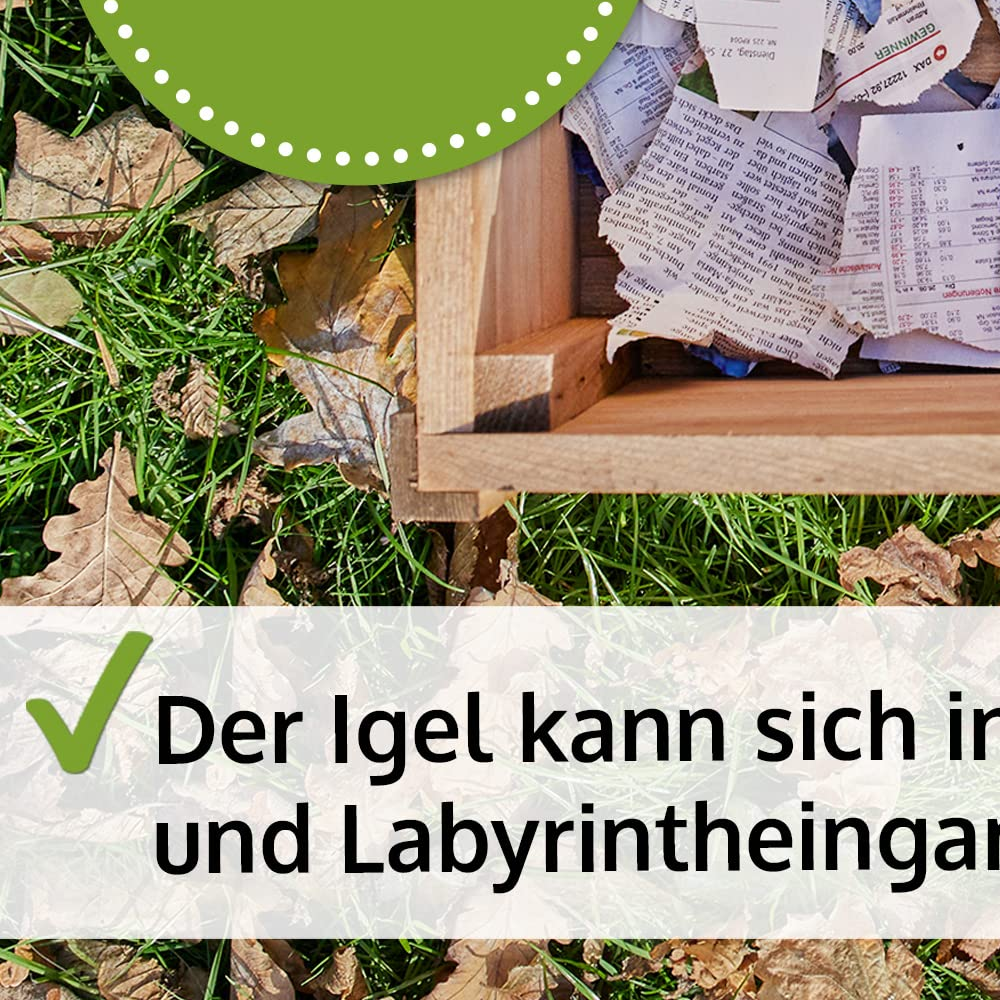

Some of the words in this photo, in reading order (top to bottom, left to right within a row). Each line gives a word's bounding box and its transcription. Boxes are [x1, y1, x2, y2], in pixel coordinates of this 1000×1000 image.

[874, 23, 935, 60] GEWINNER
[721, 48, 733, 58] 27.
[737, 47, 775, 61] Dienstag,
[913, 56, 932, 72] DAX
[728, 239, 754, 259] wurde
[758, 256, 779, 272] 1991
